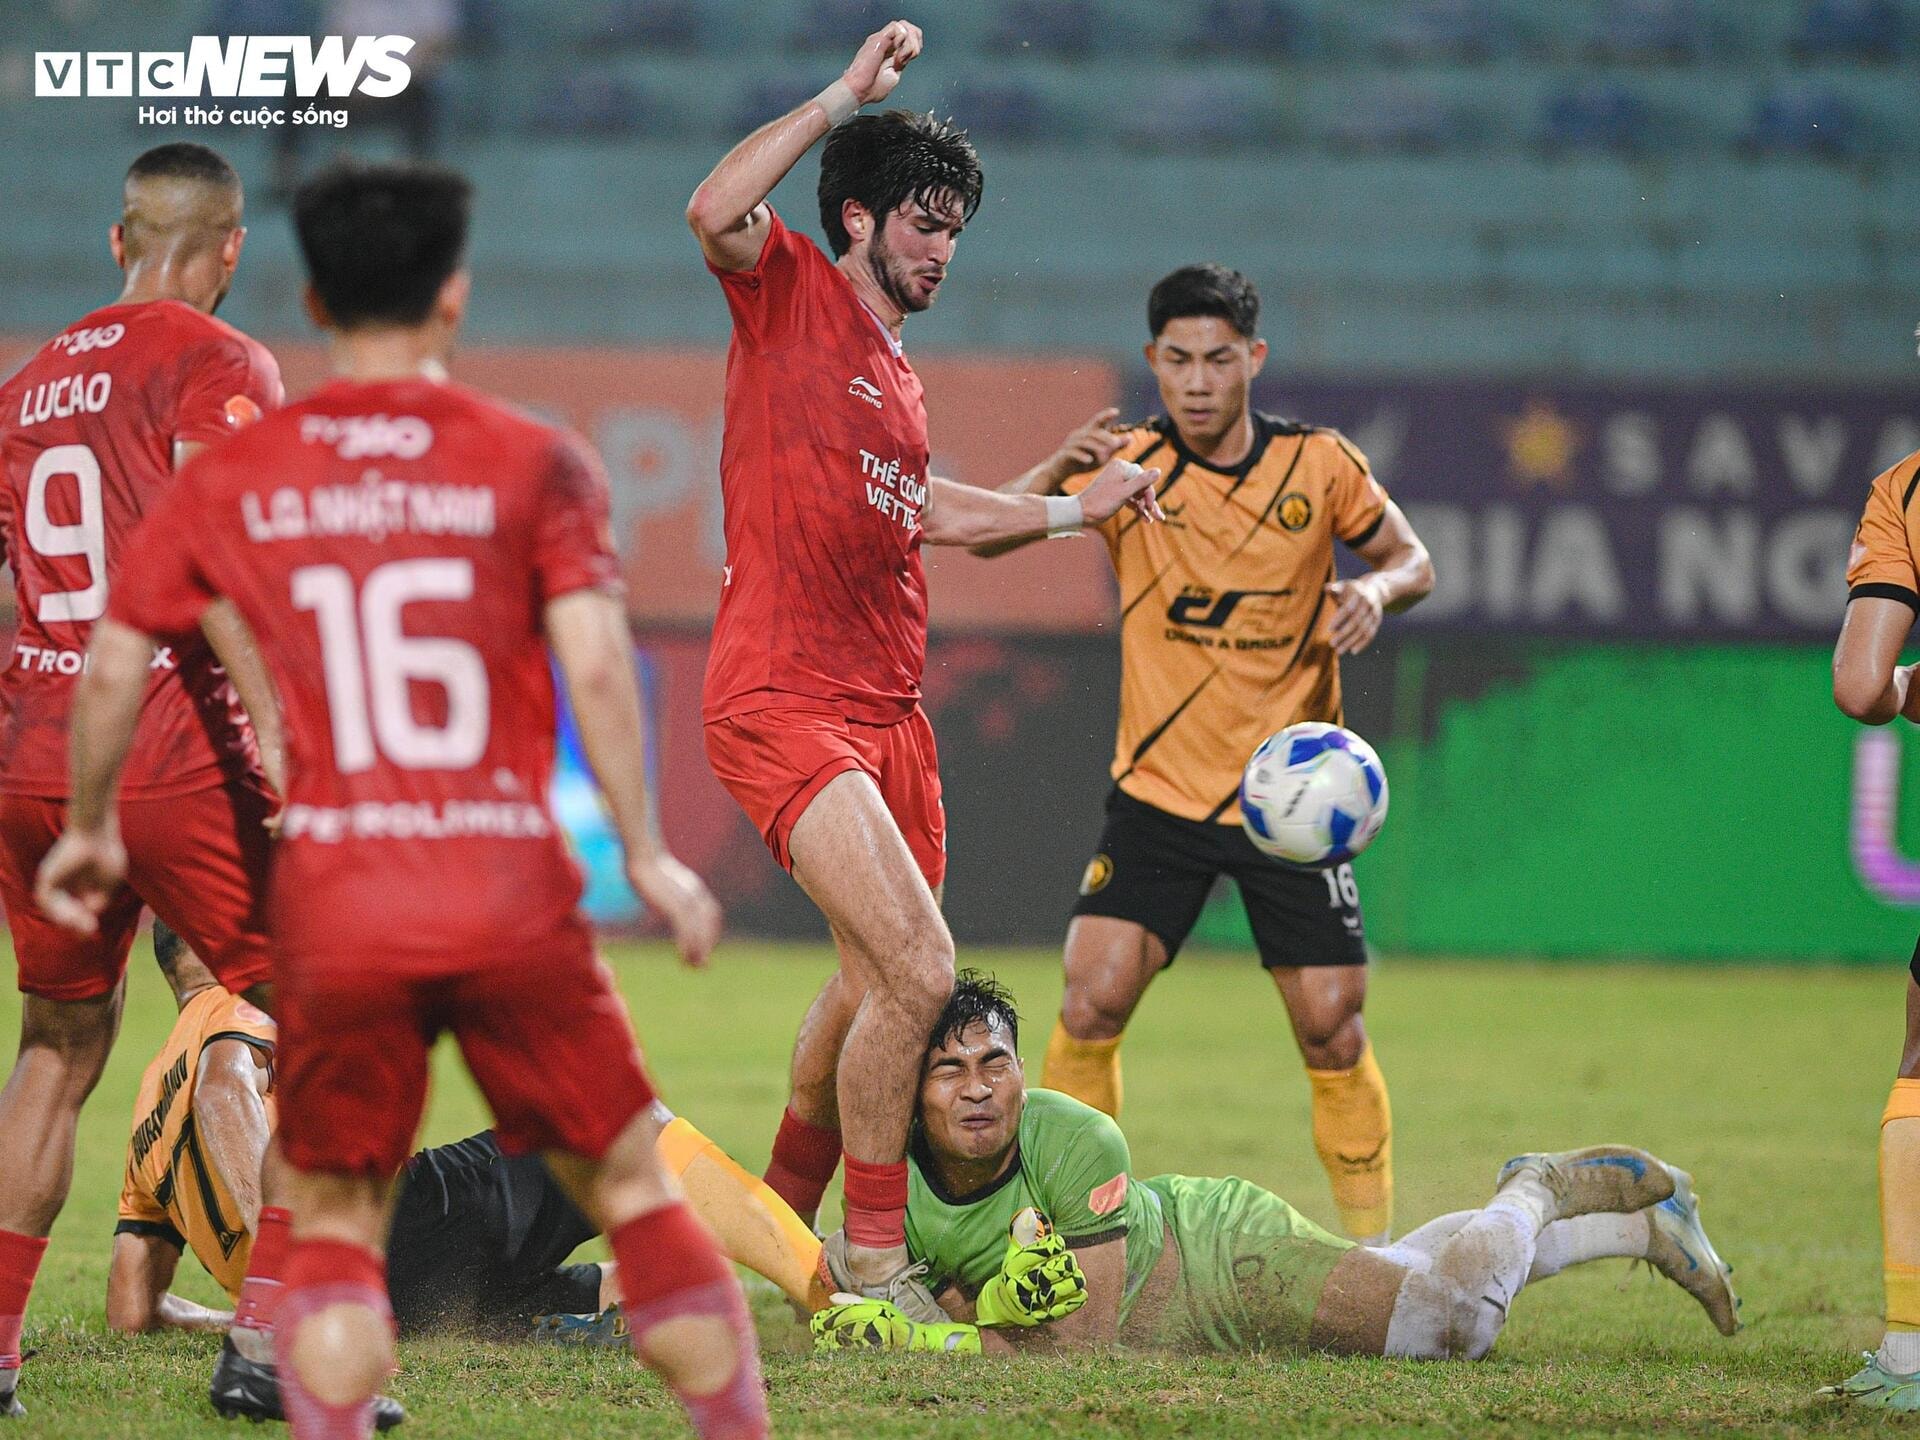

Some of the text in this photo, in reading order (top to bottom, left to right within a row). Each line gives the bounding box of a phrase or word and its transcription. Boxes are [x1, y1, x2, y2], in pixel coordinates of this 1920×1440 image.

[20, 372, 112, 427] LUCAO
[24, 443, 106, 623] 9
[865, 482, 917, 530] VIETTE
[291, 556, 489, 775] 16
[1321, 863, 1360, 909] 16
